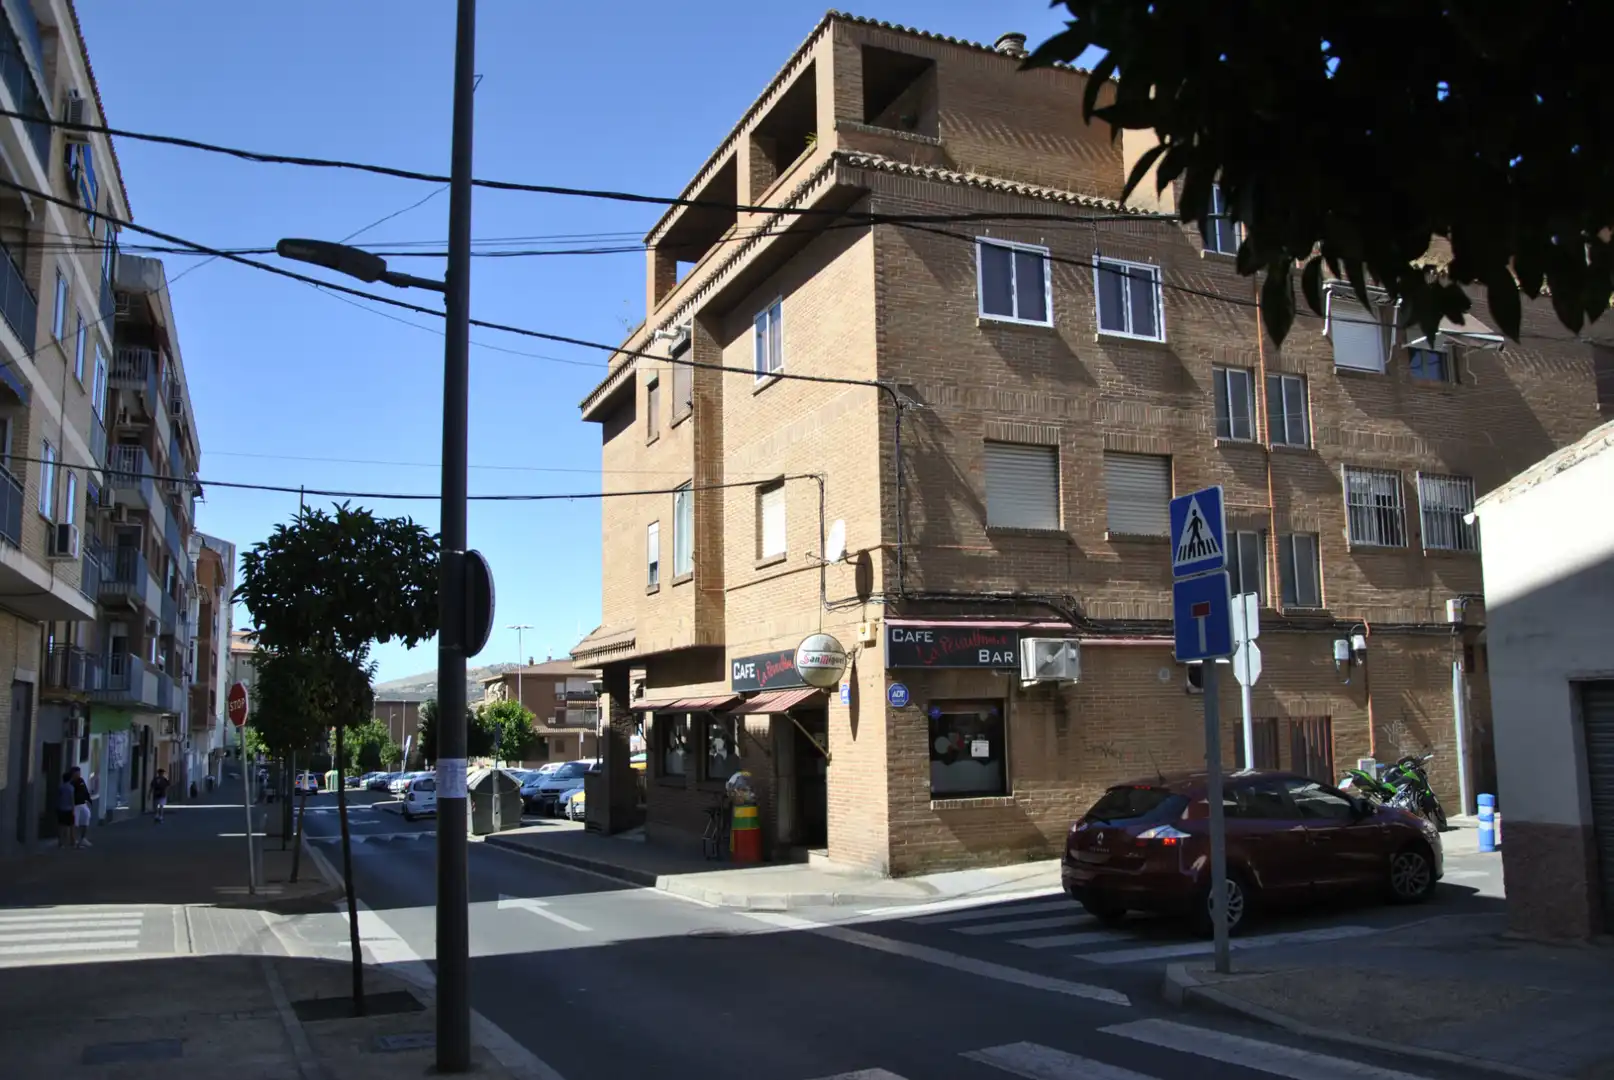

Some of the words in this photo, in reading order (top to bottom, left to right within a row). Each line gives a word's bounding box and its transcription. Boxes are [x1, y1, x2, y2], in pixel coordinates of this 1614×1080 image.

[978, 648, 1014, 663] BAR
[733, 662, 756, 680] CAFE
[891, 688, 905, 698] ADT
[229, 697, 245, 712] STOP
